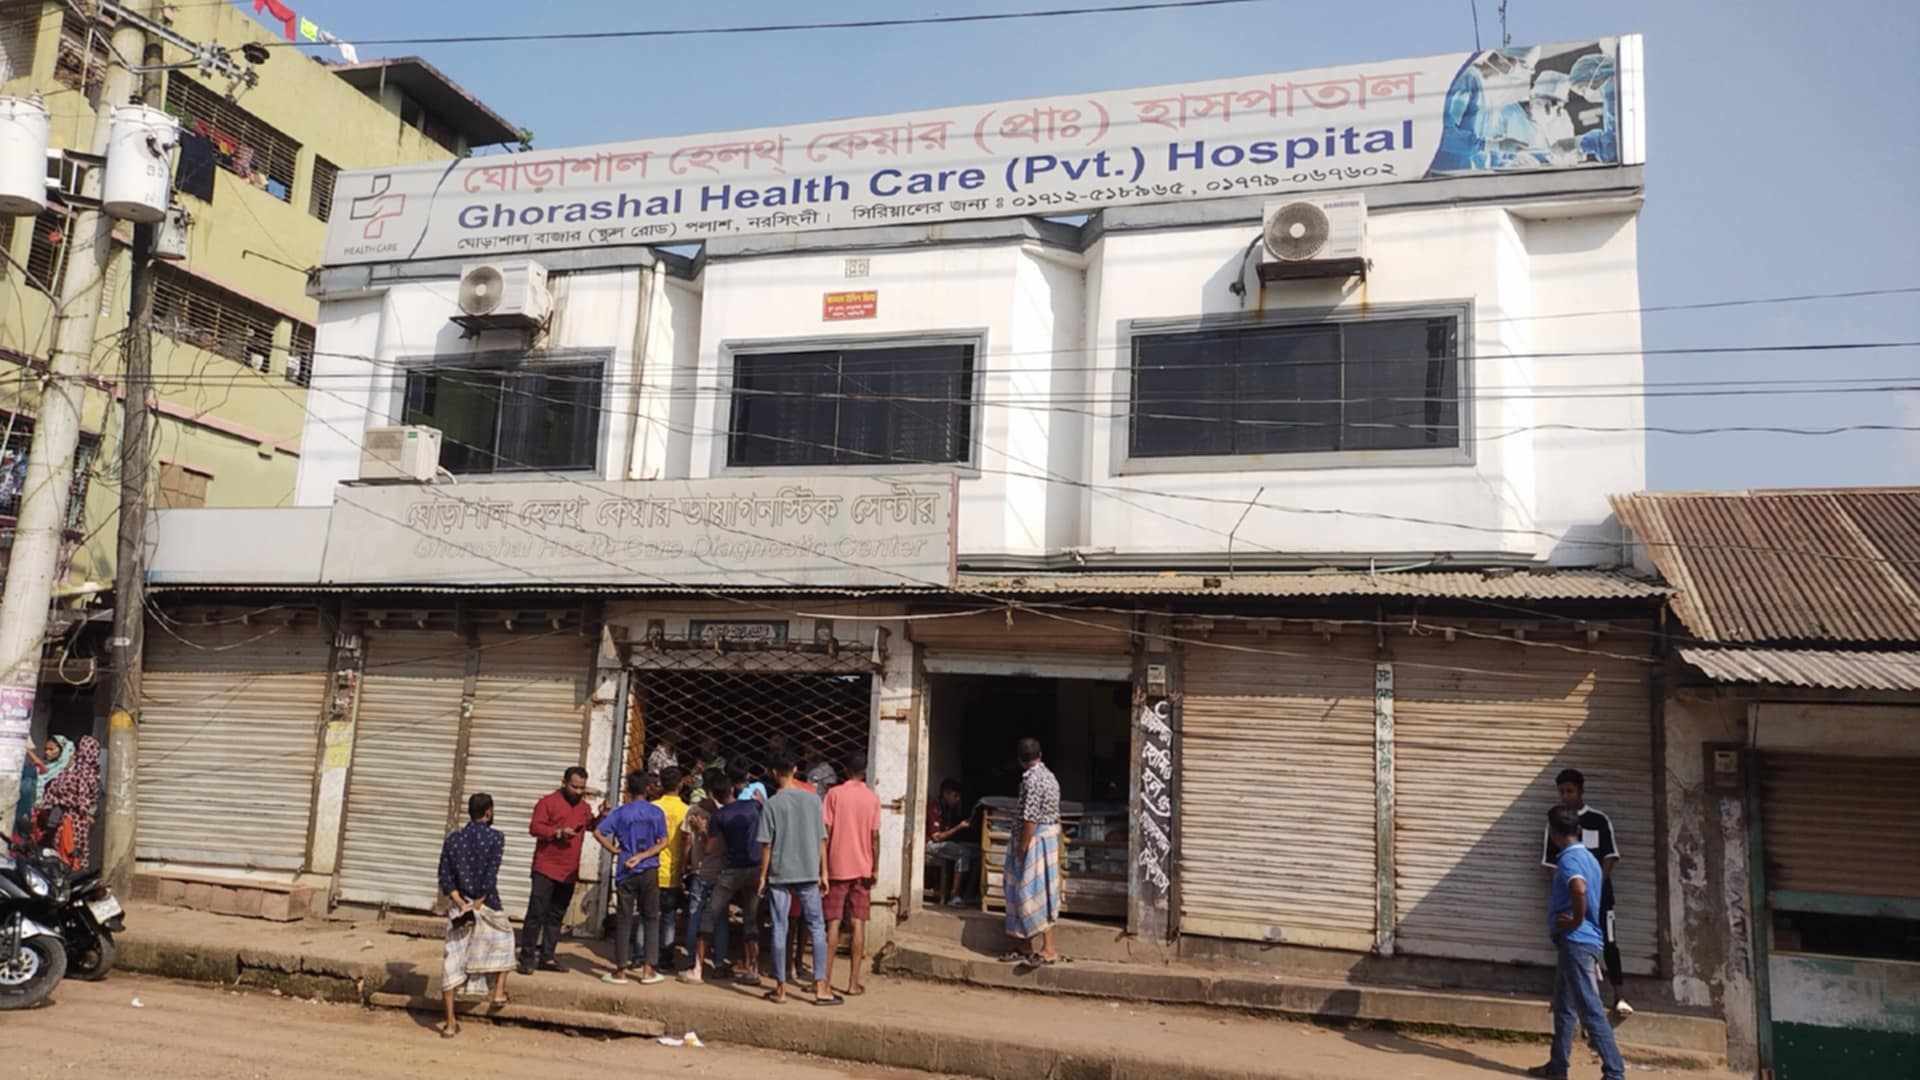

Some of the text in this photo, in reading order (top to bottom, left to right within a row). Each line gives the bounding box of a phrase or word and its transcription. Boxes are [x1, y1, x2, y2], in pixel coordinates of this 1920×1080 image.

[463, 150, 653, 193] ঘোড়াশাল
[806, 120, 954, 162] কেয়ার
[1132, 72, 1423, 129] হাসপাতাল
[458, 119, 1414, 229] Ghorashal Health Care (Pvt.) Hospital
[457, 233, 528, 249] ঘোড়াশাল
[535, 230, 582, 243] বাজার
[631, 222, 677, 238] রোড)
[853, 202, 944, 219] সিরিয়ালের
[950, 198, 988, 211] জন্য
[596, 494, 676, 528] কেয়ার
